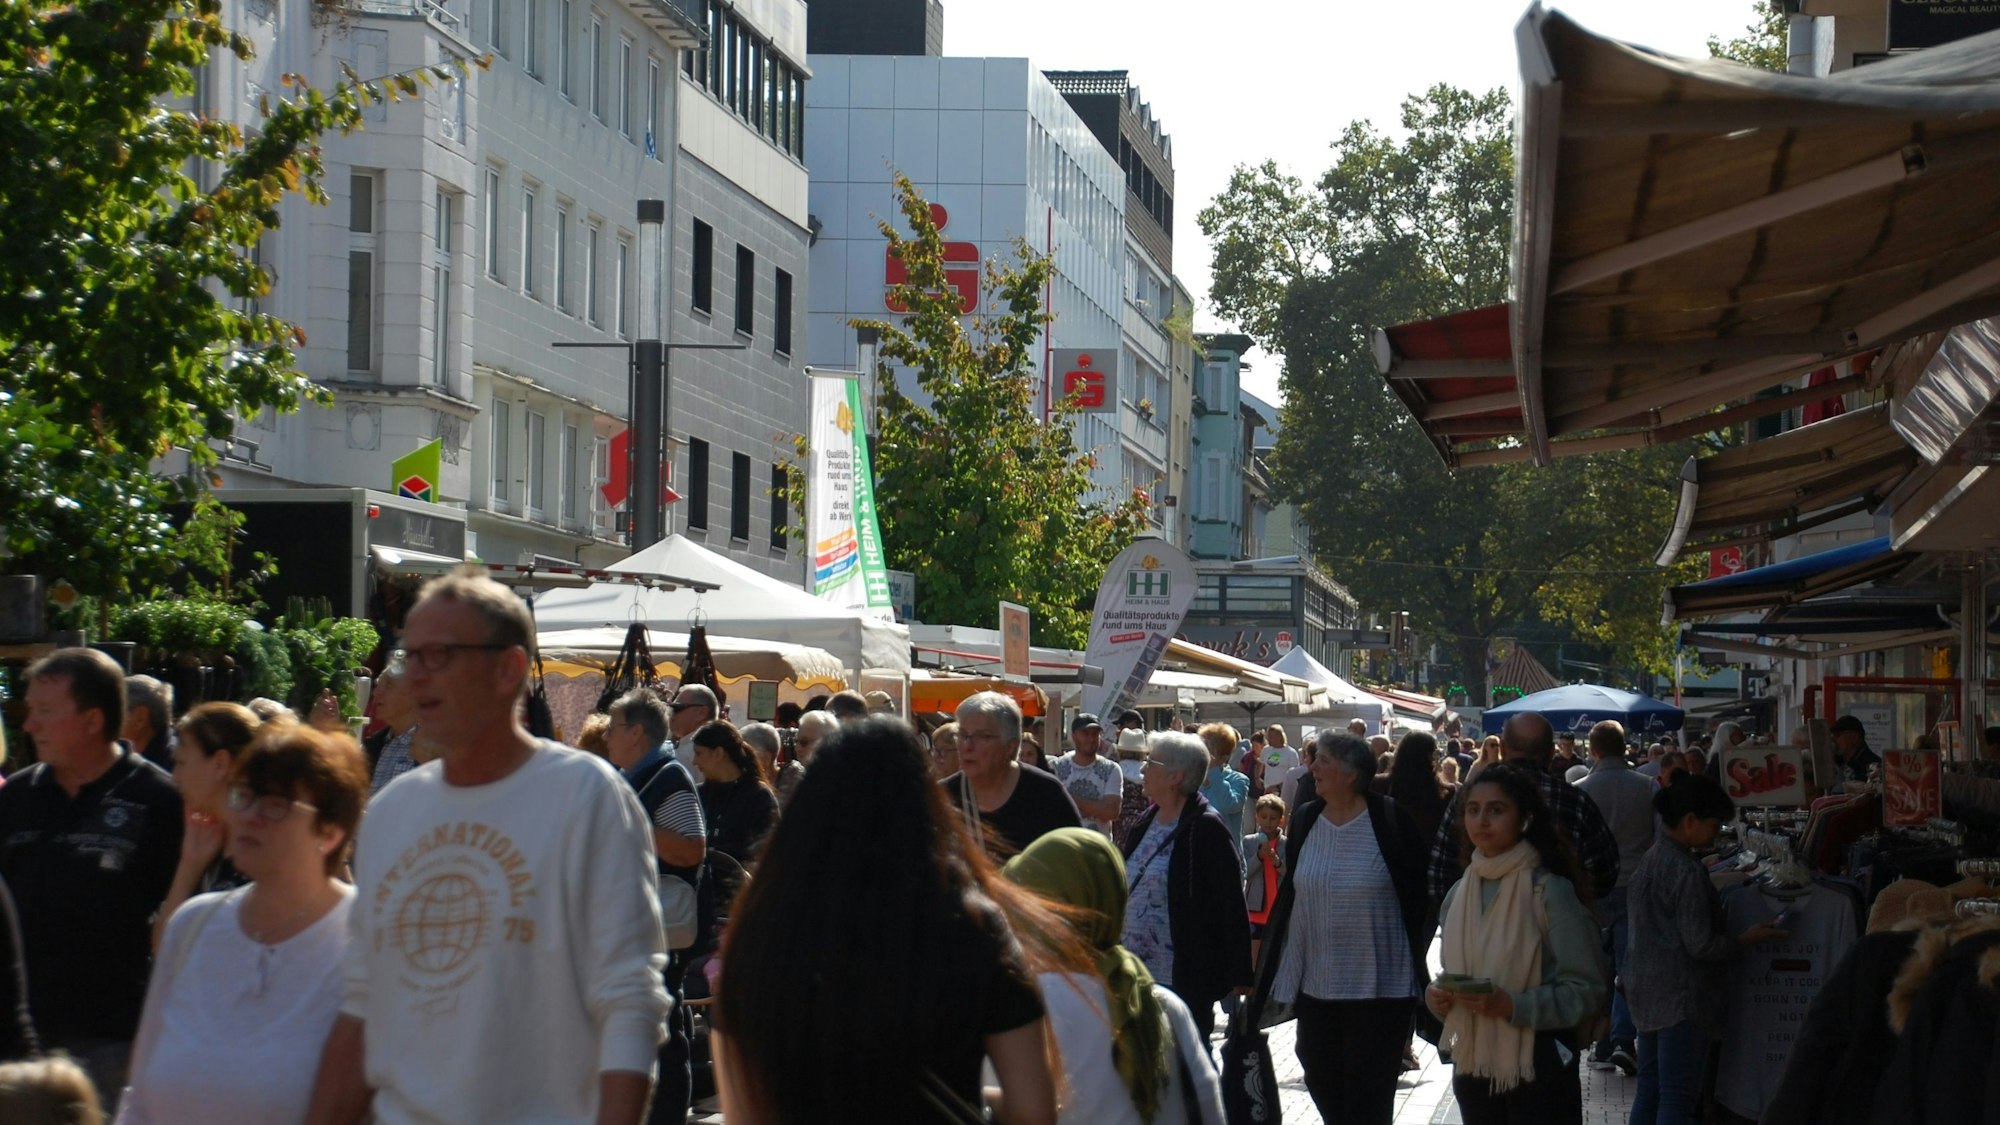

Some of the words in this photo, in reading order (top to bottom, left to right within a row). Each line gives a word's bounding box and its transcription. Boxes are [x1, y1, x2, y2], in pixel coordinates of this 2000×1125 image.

[1929, 6, 1967, 14] MAGICAL
[1969, 5, 2000, 13] BEAUT
[827, 471, 840, 480] rund
[834, 482, 848, 491] Haus
[833, 500, 850, 510] direkt
[858, 501, 870, 514] &
[829, 512, 838, 521] ab
[860, 518, 881, 566] HEIM
[1103, 610, 1180, 622] Qualitätsprodukte
[1102, 621, 1122, 630] rund
[1124, 622, 1143, 630] ums
[1145, 621, 1167, 630] Haus
[1726, 753, 1797, 798] Sale
[1891, 786, 1935, 811] SALE
[373, 822, 537, 914] INTERNATIONAL
[503, 916, 536, 945] 75
[1784, 978, 1794, 987] IT
[1754, 994, 1789, 1004] BORN
[1793, 995, 1807, 1004] TO
